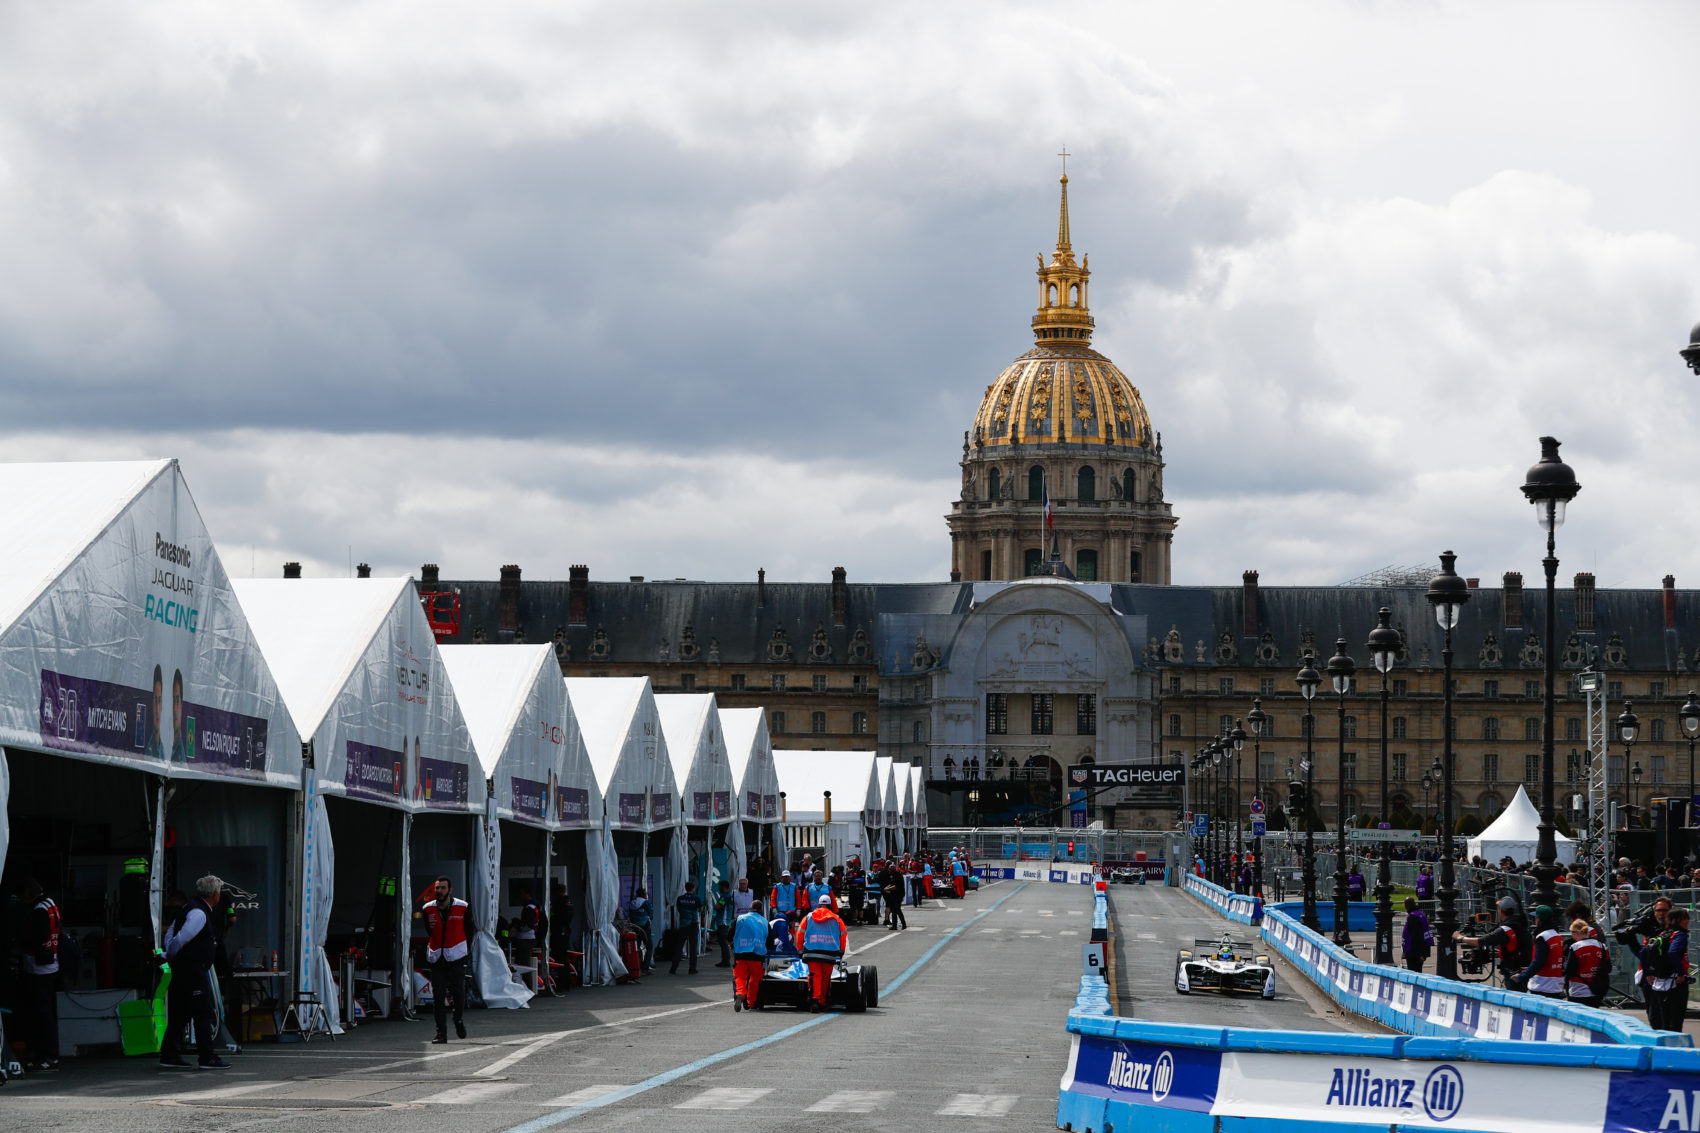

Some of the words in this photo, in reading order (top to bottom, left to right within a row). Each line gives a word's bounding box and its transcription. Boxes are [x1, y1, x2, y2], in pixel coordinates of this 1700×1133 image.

[155, 531, 191, 568] Panasonic
[151, 567, 194, 597] JAGUAR
[144, 593, 198, 634] RACING
[58, 687, 77, 742] 20
[87, 706, 108, 730] MITCH
[108, 709, 127, 732] EVANS
[202, 729, 222, 753] NELSON
[1198, 816, 1205, 826] P
[1088, 952, 1099, 967] 6
[1107, 1051, 1152, 1091] Allianz
[1326, 1067, 1416, 1109] Allianz
